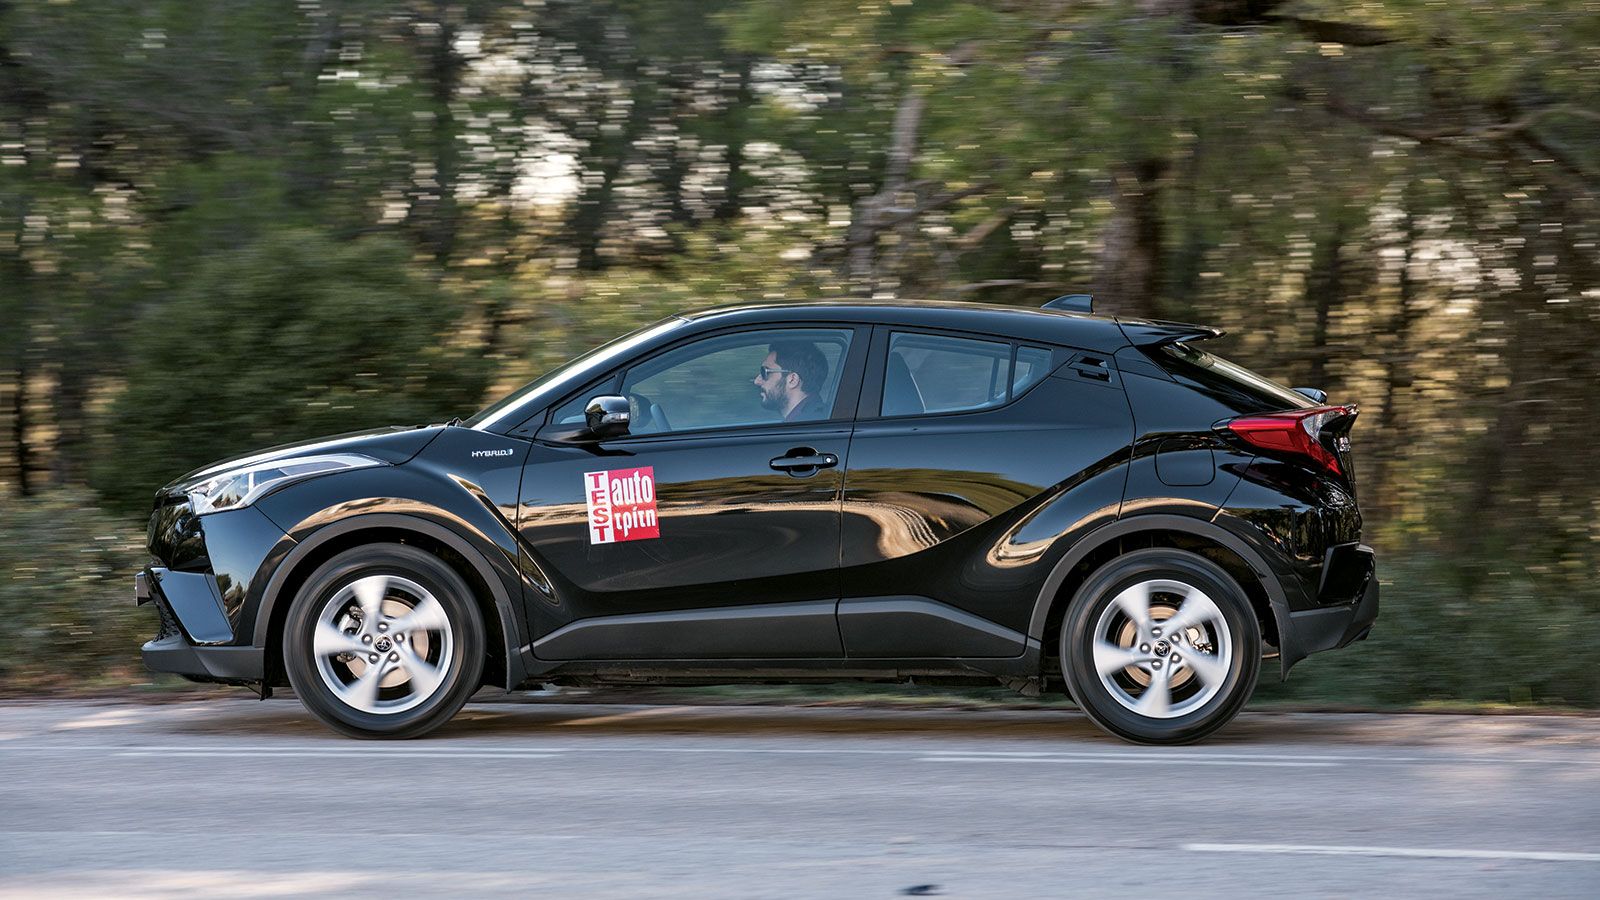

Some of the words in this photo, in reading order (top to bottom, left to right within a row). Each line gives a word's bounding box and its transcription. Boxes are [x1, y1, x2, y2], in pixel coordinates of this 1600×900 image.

[471, 449, 507, 458] HYBRID
[611, 470, 653, 506] auto
[588, 473, 609, 541] TEST
